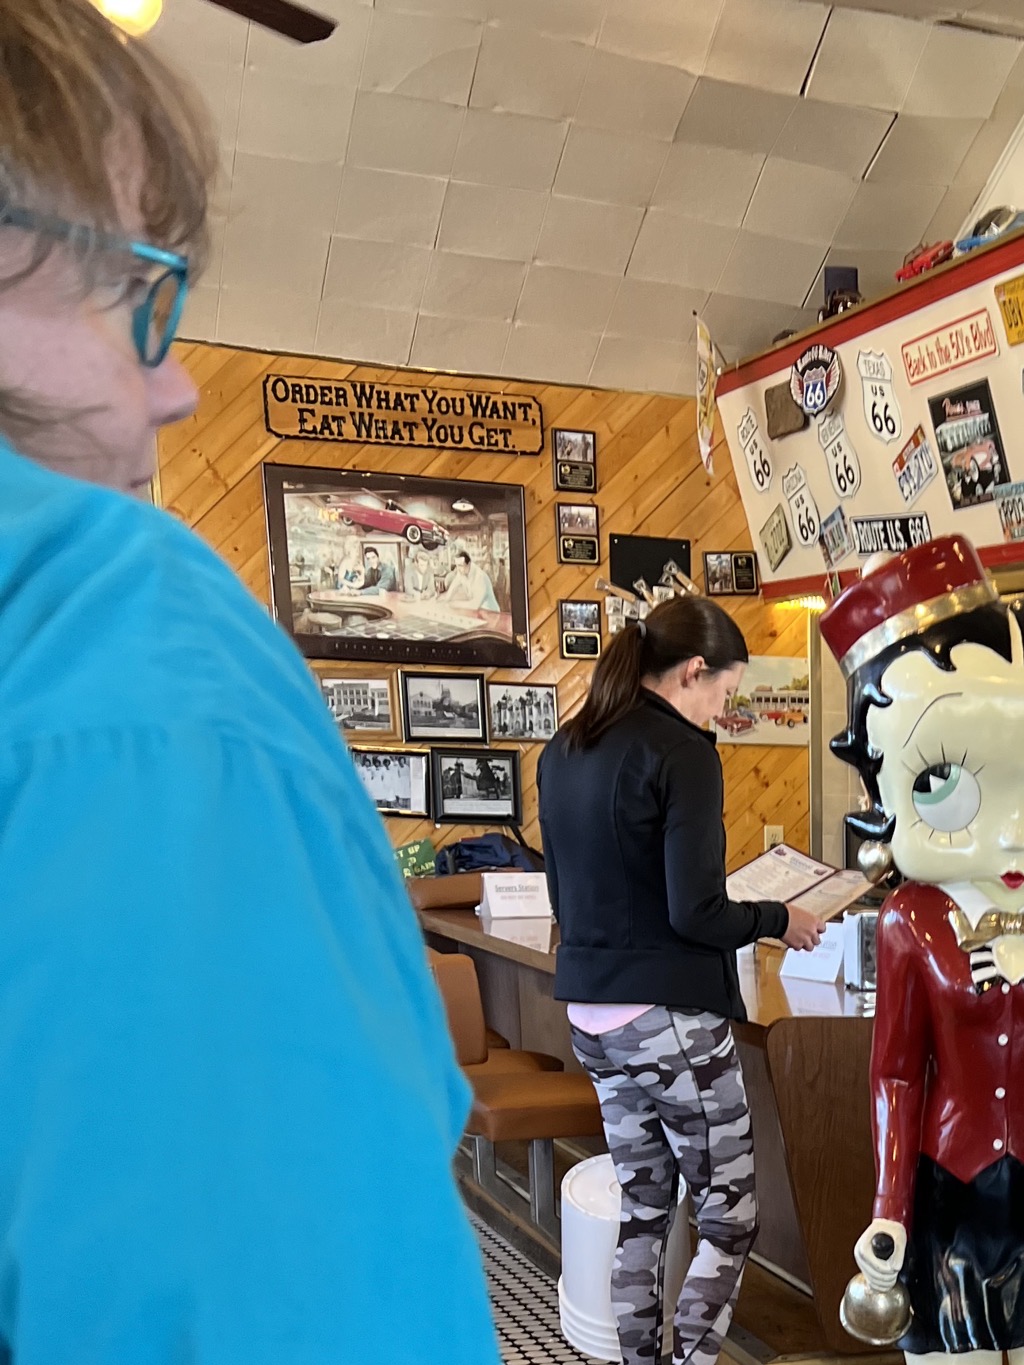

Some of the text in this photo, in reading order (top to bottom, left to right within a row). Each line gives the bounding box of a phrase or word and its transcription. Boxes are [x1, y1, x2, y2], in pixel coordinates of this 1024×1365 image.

[905, 345, 927, 378] Back
[927, 346, 937, 369] to
[935, 336, 951, 364] the
[970, 314, 995, 352] Blvd
[864, 360, 885, 377] TEXAS
[271, 377, 537, 426] ORDER WHAT YOU WANT,
[806, 382, 824, 406] 66
[297, 408, 516, 449] EAT WHAT YOU GET.
[872, 401, 896, 434] 66
[754, 449, 770, 487] 66
[835, 455, 854, 492] 66
[799, 507, 816, 541] 66
[857, 521, 888, 552] ROUTE
[886, 519, 908, 551] U.S.
[495, 884, 539, 892] Servers Station
